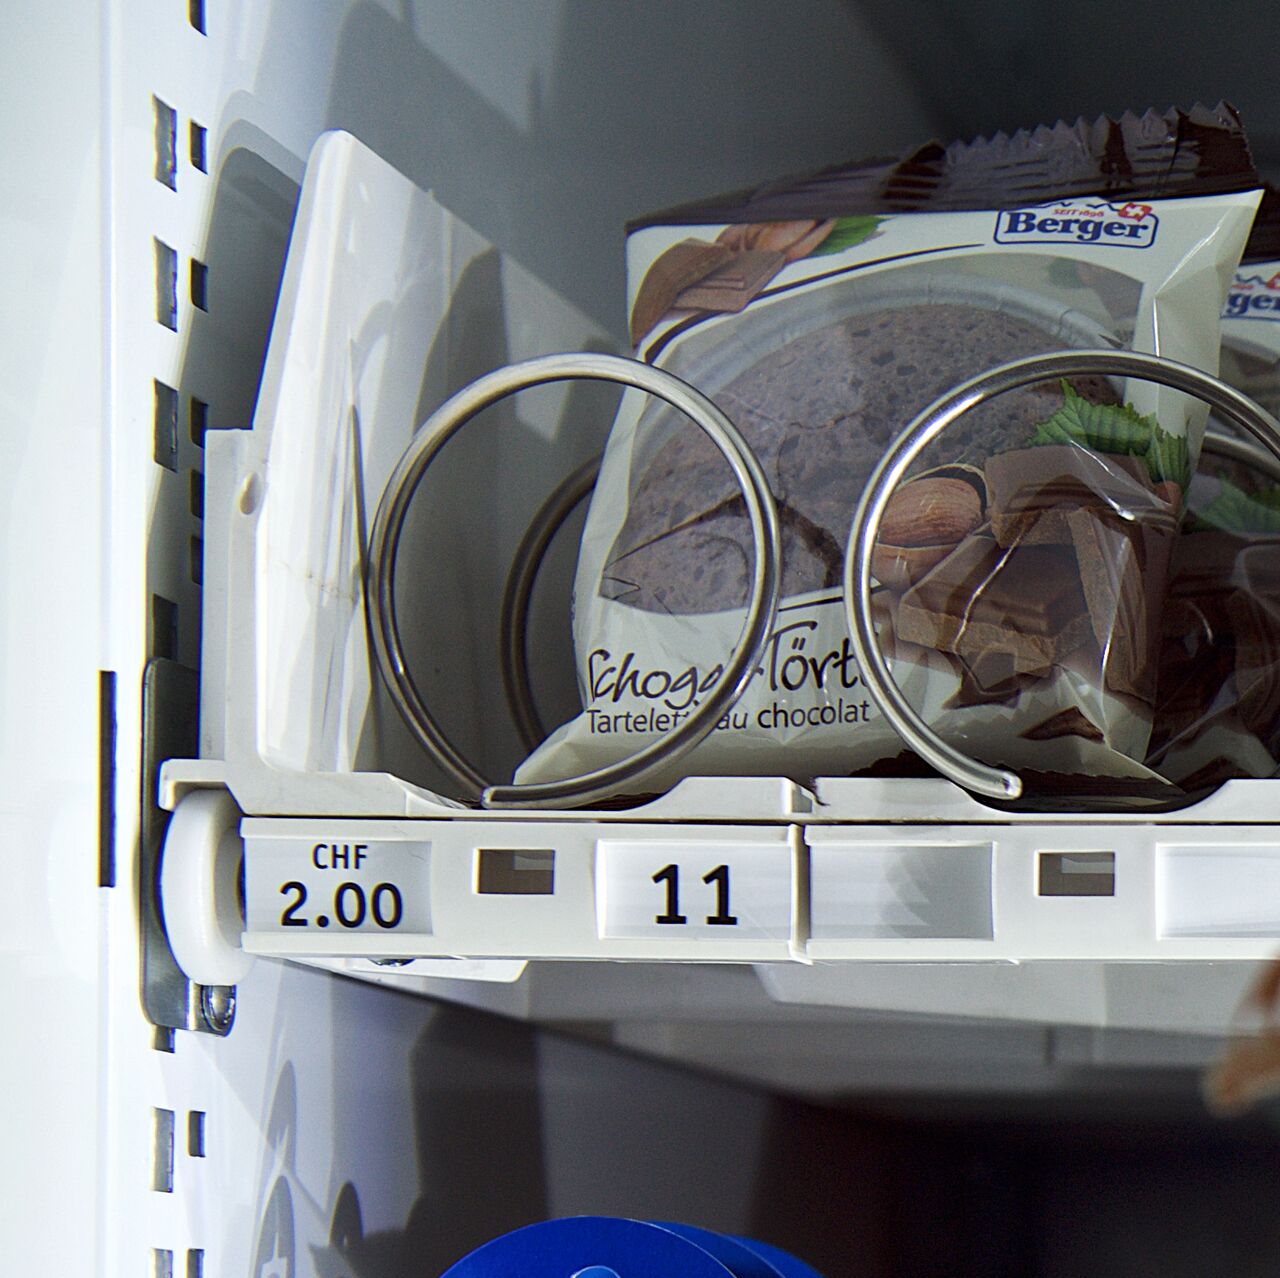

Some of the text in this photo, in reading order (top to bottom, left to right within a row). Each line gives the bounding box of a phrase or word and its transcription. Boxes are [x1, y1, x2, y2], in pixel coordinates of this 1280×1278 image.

[1004, 211, 1149, 242] Berger
[588, 620, 868, 711] Schog-Tört
[587, 708, 691, 733] Tartelet
[757, 699, 870, 729] chocolat
[312, 844, 368, 870] CHF
[279, 881, 402, 929] 2.00
[652, 864, 739, 925] 11
